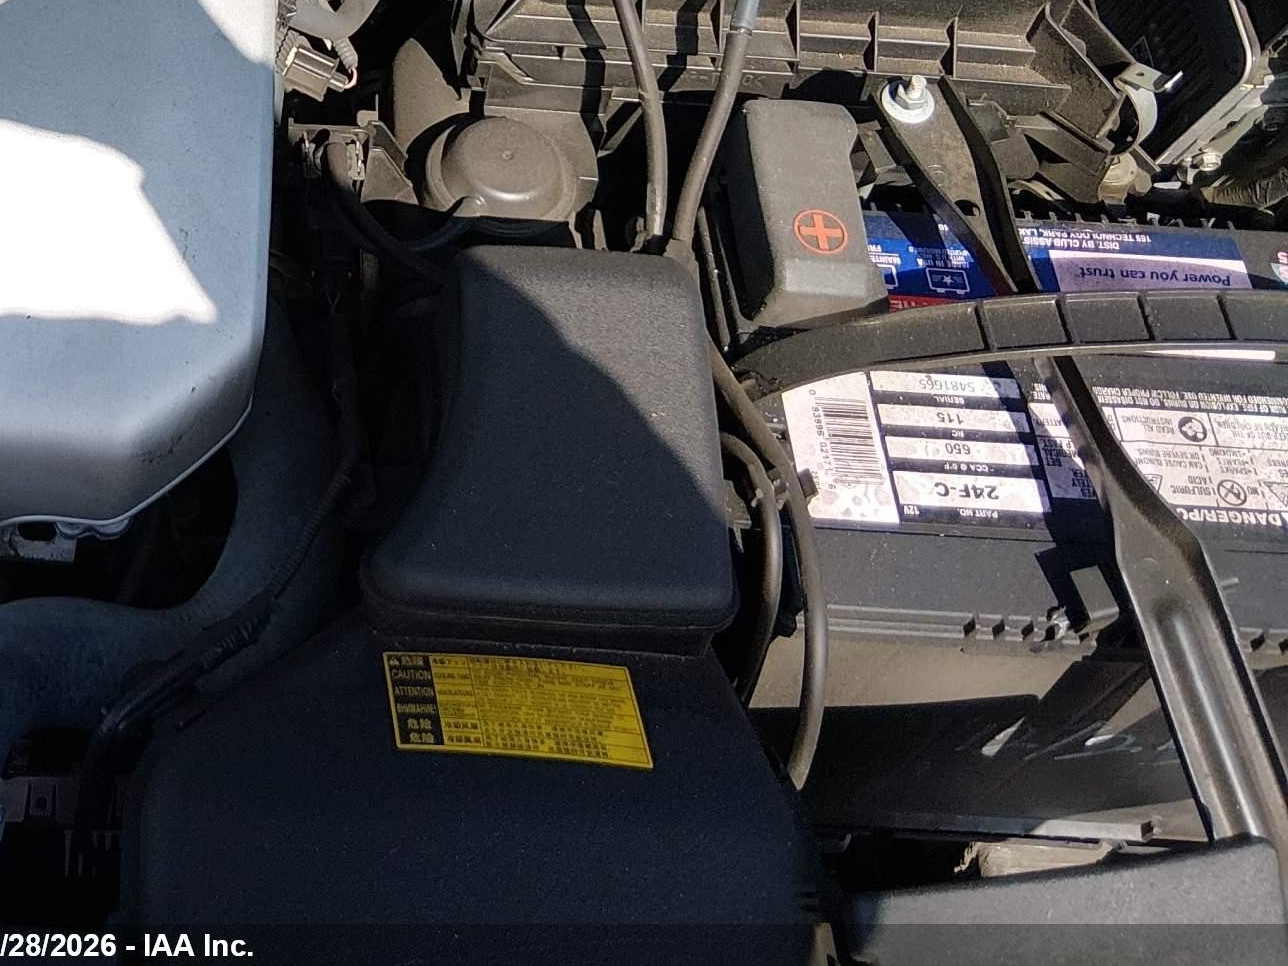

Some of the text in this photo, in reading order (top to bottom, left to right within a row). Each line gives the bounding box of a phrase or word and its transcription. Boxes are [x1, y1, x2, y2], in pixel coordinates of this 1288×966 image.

[1053, 238, 1079, 248] CLUB
[1082, 239, 1095, 249] BY
[1120, 269, 1146, 280] can
[1150, 270, 1178, 282] you
[1183, 273, 1231, 287] Power
[933, 395, 965, 404] SERIAL
[1134, 396, 1149, 406] NOT
[1149, 397, 1161, 407] DO
[936, 412, 964, 425] 115
[951, 430, 964, 438] RC
[1143, 424, 1175, 435] READ ALL
[945, 443, 971, 455] 650
[1162, 451, 1189, 459] SEVERE
[1191, 452, 1200, 460] OR
[1045, 457, 1062, 467] GET
[1163, 459, 1187, 468] CAUSE
[1189, 461, 1203, 469] CAN
[969, 464, 989, 472] CCA
[1188, 475, 1207, 484] ACID
[934, 482, 999, 500] 24F-C
[1170, 485, 1211, 495] SULFURIC
[1247, 486, 1259, 496] NO
[903, 505, 920, 515] 12V
[957, 508, 998, 518] PART NO.
[392, 669, 432, 680] CAUTION
[394, 685, 434, 697] ATTENTION
